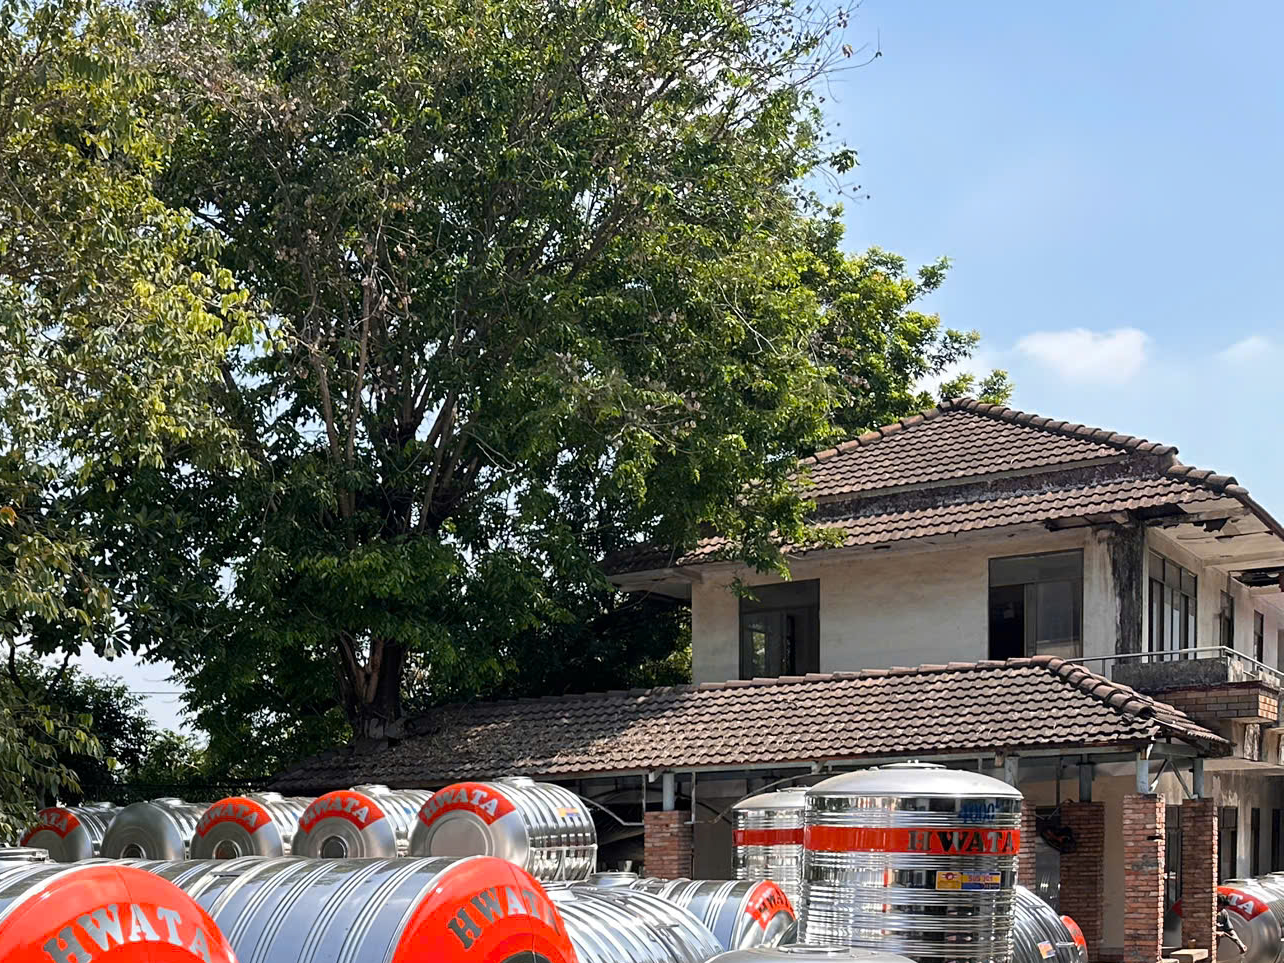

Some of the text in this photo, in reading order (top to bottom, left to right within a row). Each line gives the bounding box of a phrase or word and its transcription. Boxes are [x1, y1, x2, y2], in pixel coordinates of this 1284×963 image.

[198, 803, 258, 831] HWATA
[302, 796, 370, 825] HWATA
[422, 788, 498, 819] HWATA
[908, 831, 1015, 853] HWATA
[448, 886, 561, 950] HWATA
